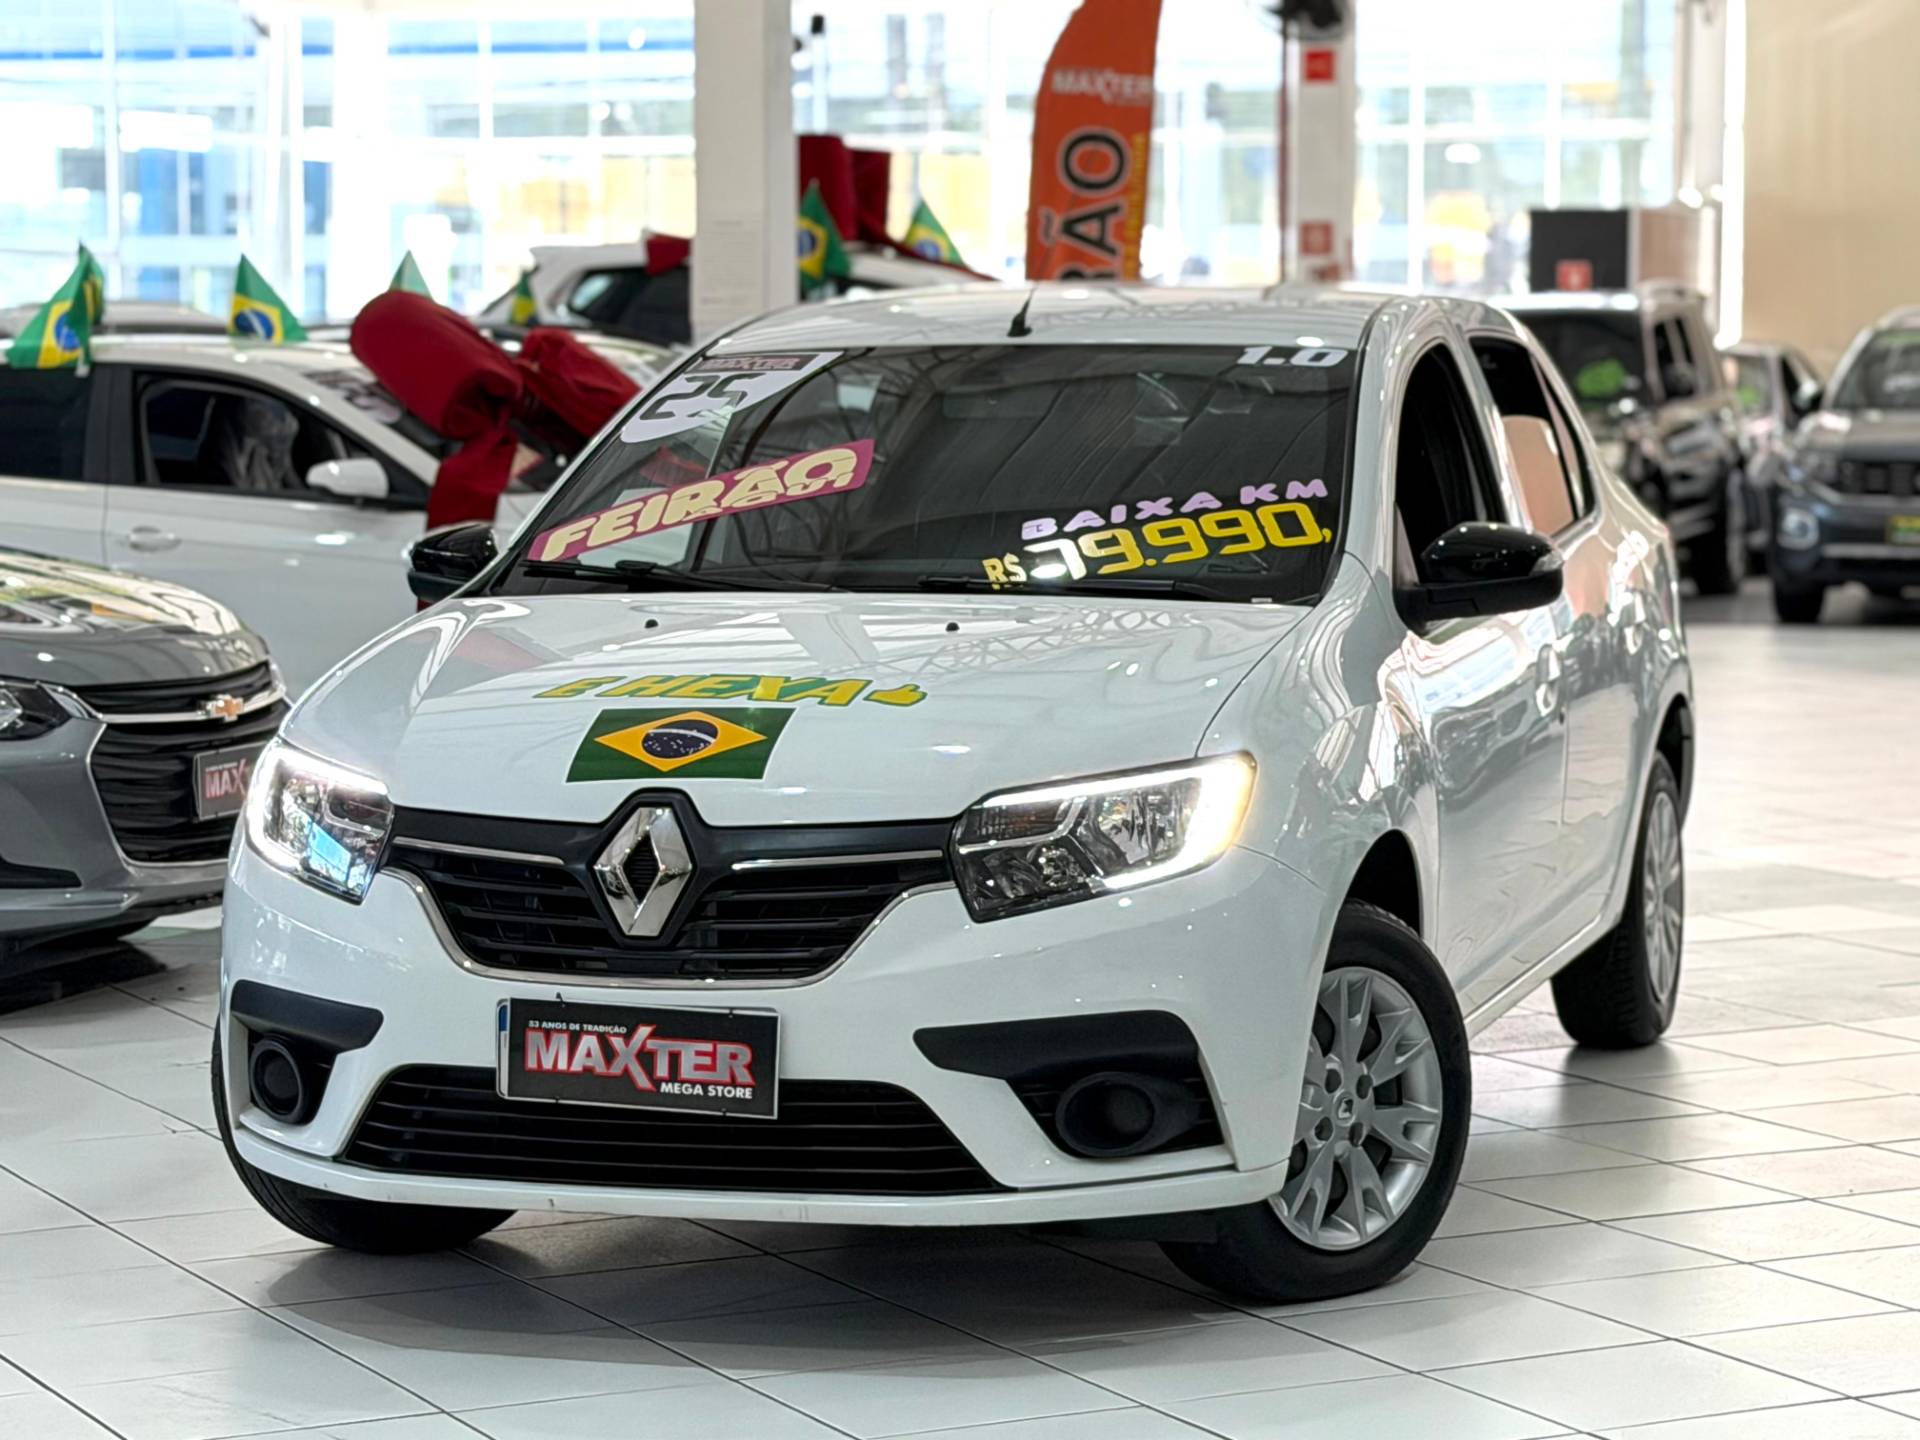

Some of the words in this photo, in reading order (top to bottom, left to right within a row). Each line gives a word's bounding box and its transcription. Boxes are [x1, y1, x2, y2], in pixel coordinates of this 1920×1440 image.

[1237, 346, 1349, 367] 1.0
[639, 373, 766, 420] 25
[541, 449, 857, 562] FEIRÃO
[1021, 491, 1223, 541] BAIXA
[1239, 479, 1328, 505] KM
[594, 674, 871, 706] HEXA
[541, 1021, 567, 1030] ANOS
[569, 1023, 581, 1031] DE
[582, 1024, 627, 1034] TRADIÇÃO
[524, 1024, 756, 1092] MAXTER
[660, 1081, 703, 1096] MEGA
[707, 1085, 753, 1099] STORE
